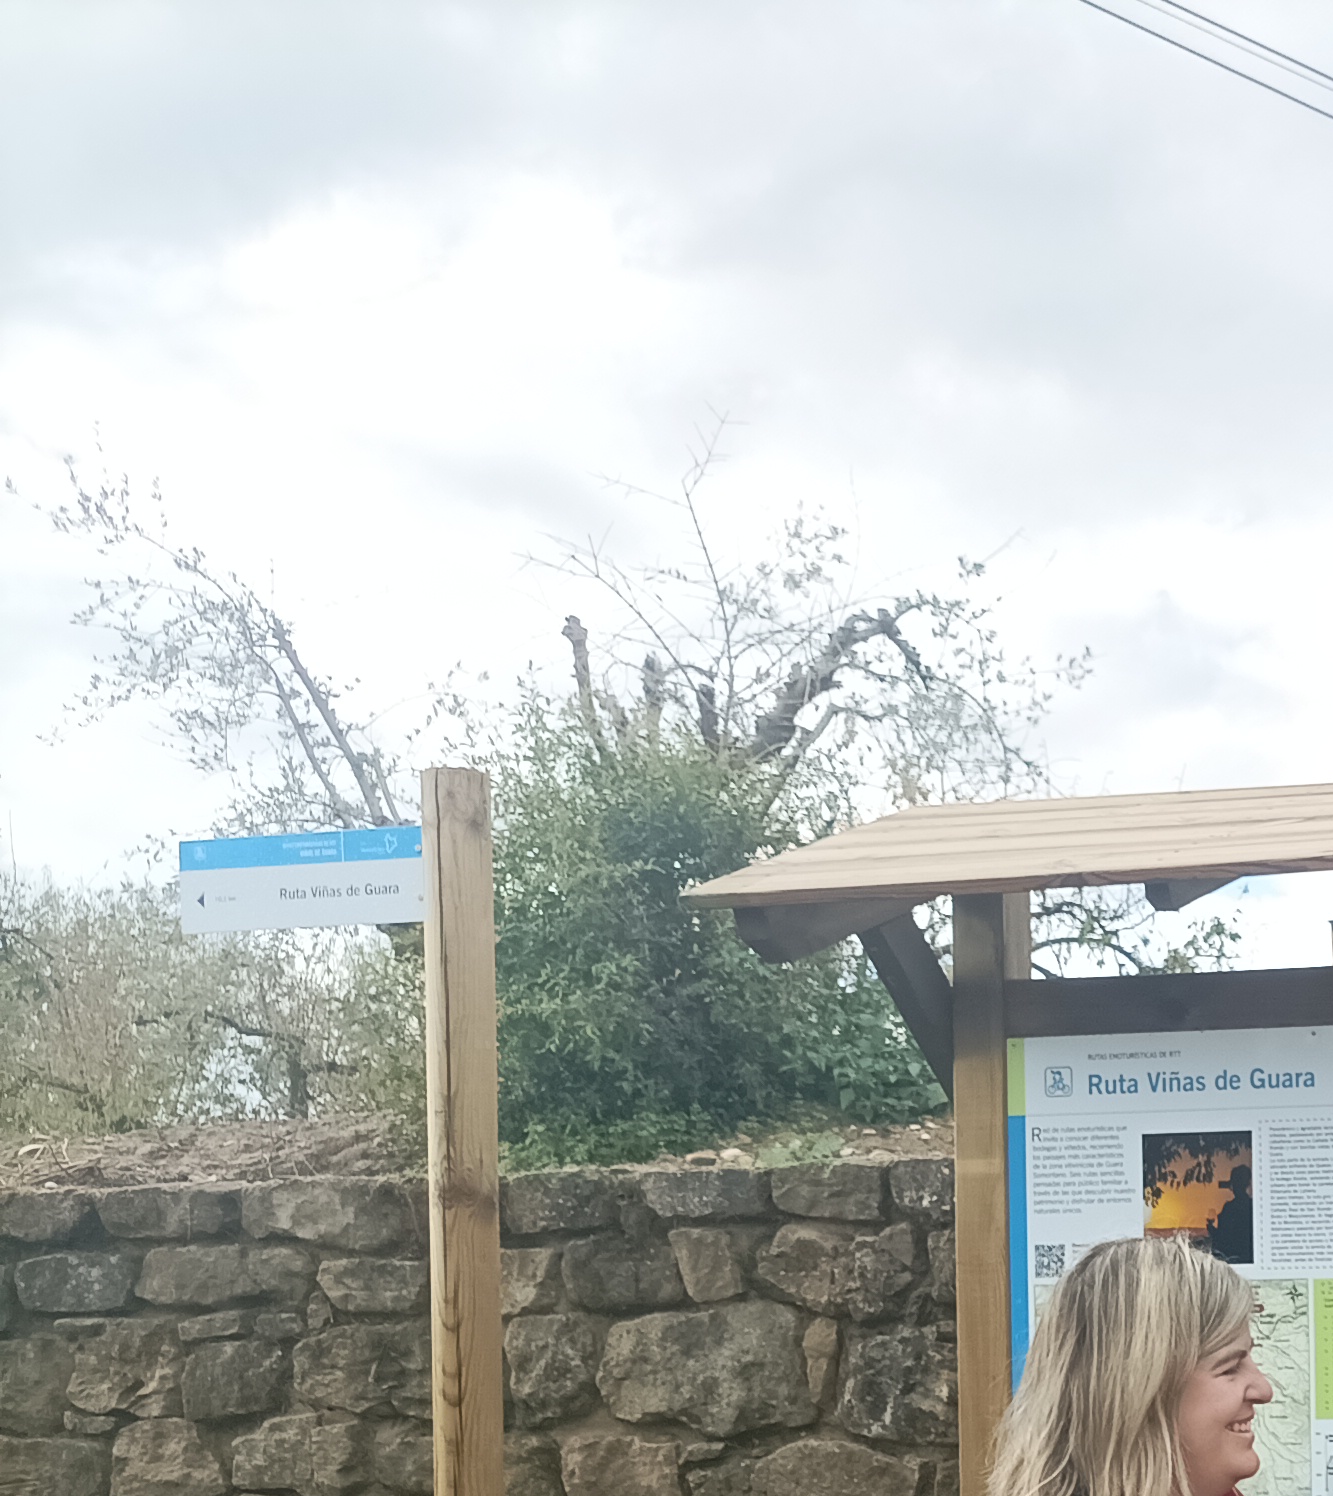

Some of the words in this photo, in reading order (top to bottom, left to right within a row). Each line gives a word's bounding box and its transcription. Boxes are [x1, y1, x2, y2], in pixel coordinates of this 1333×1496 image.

[280, 888, 306, 899] Ruta
[311, 885, 342, 898] Viñas
[346, 884, 360, 897] de
[364, 883, 400, 896] Guara
[1088, 1074, 1139, 1095] Ruta
[1147, 1071, 1206, 1093] Viñas
[1215, 1069, 1241, 1091] de
[1250, 1067, 1315, 1089] Guara
